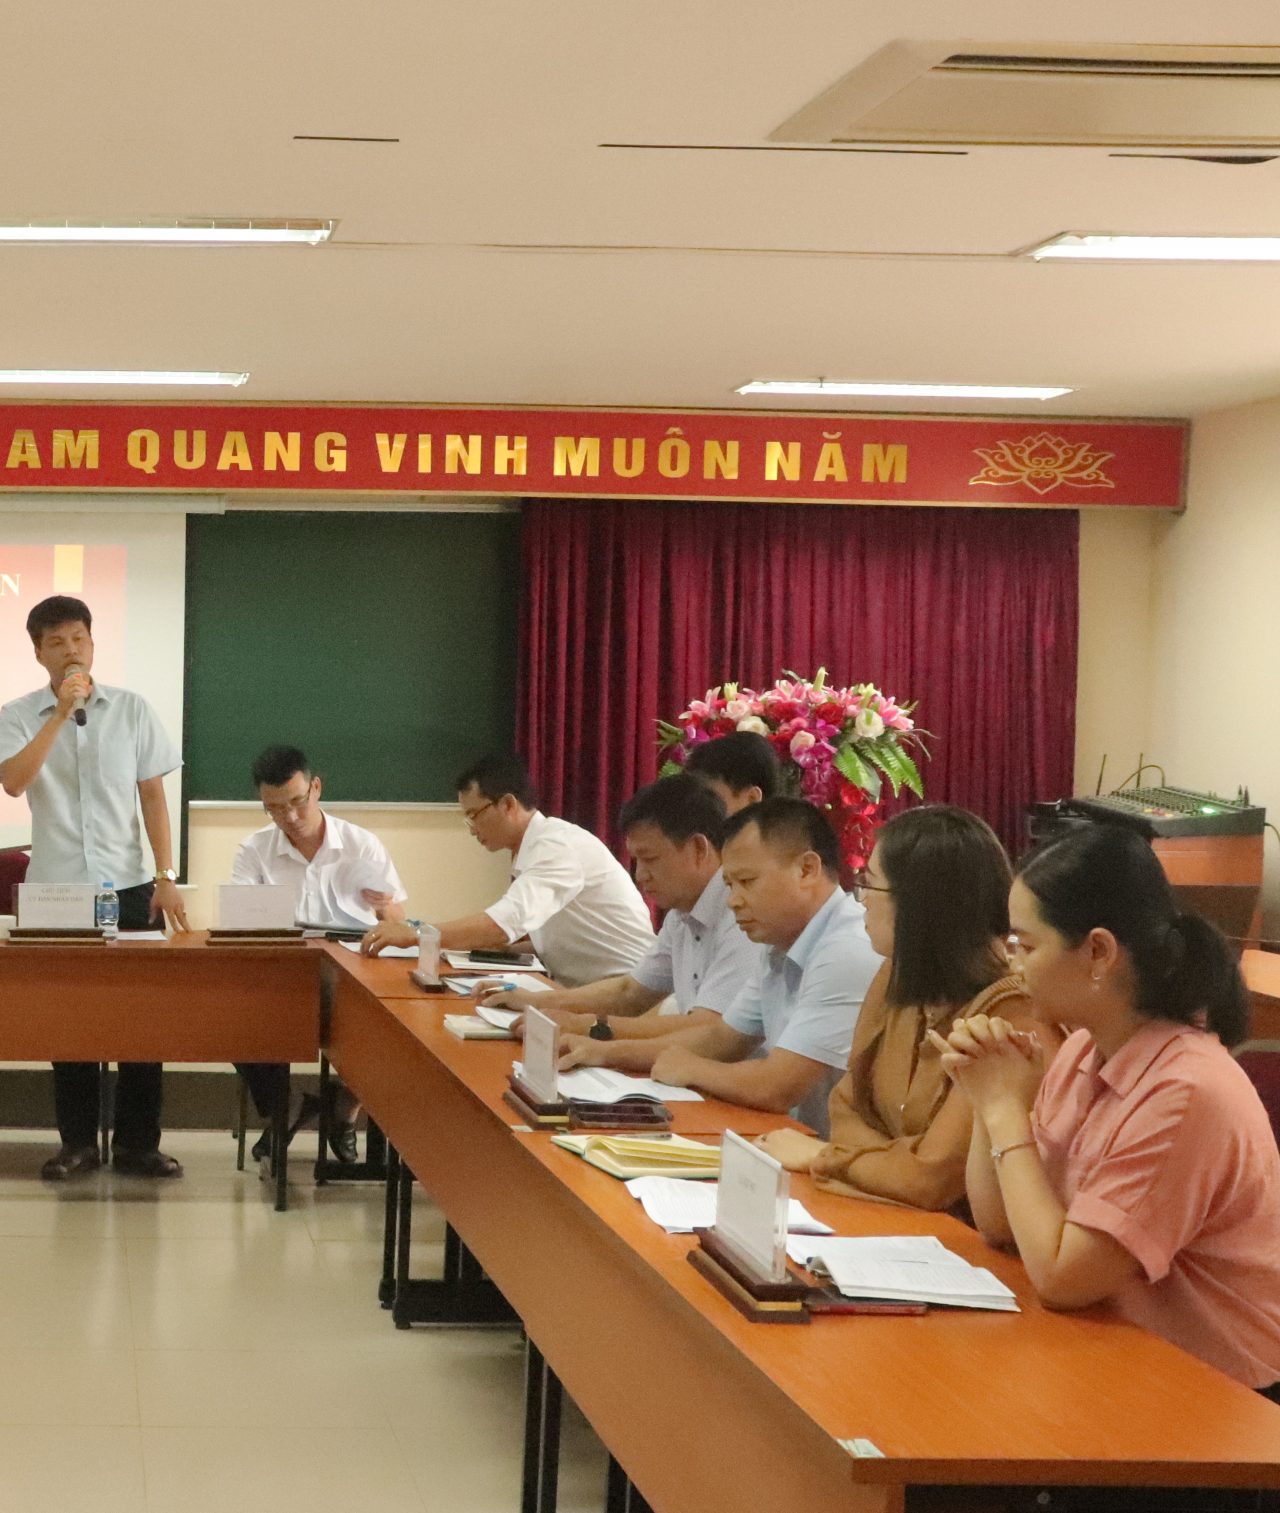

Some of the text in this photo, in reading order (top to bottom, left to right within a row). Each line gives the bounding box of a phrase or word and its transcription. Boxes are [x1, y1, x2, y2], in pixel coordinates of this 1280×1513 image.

[126, 428, 348, 475] QUANG
[374, 432, 528, 476] VINH
[552, 426, 740, 481] MUÔN
[764, 431, 908, 484] NĂM
